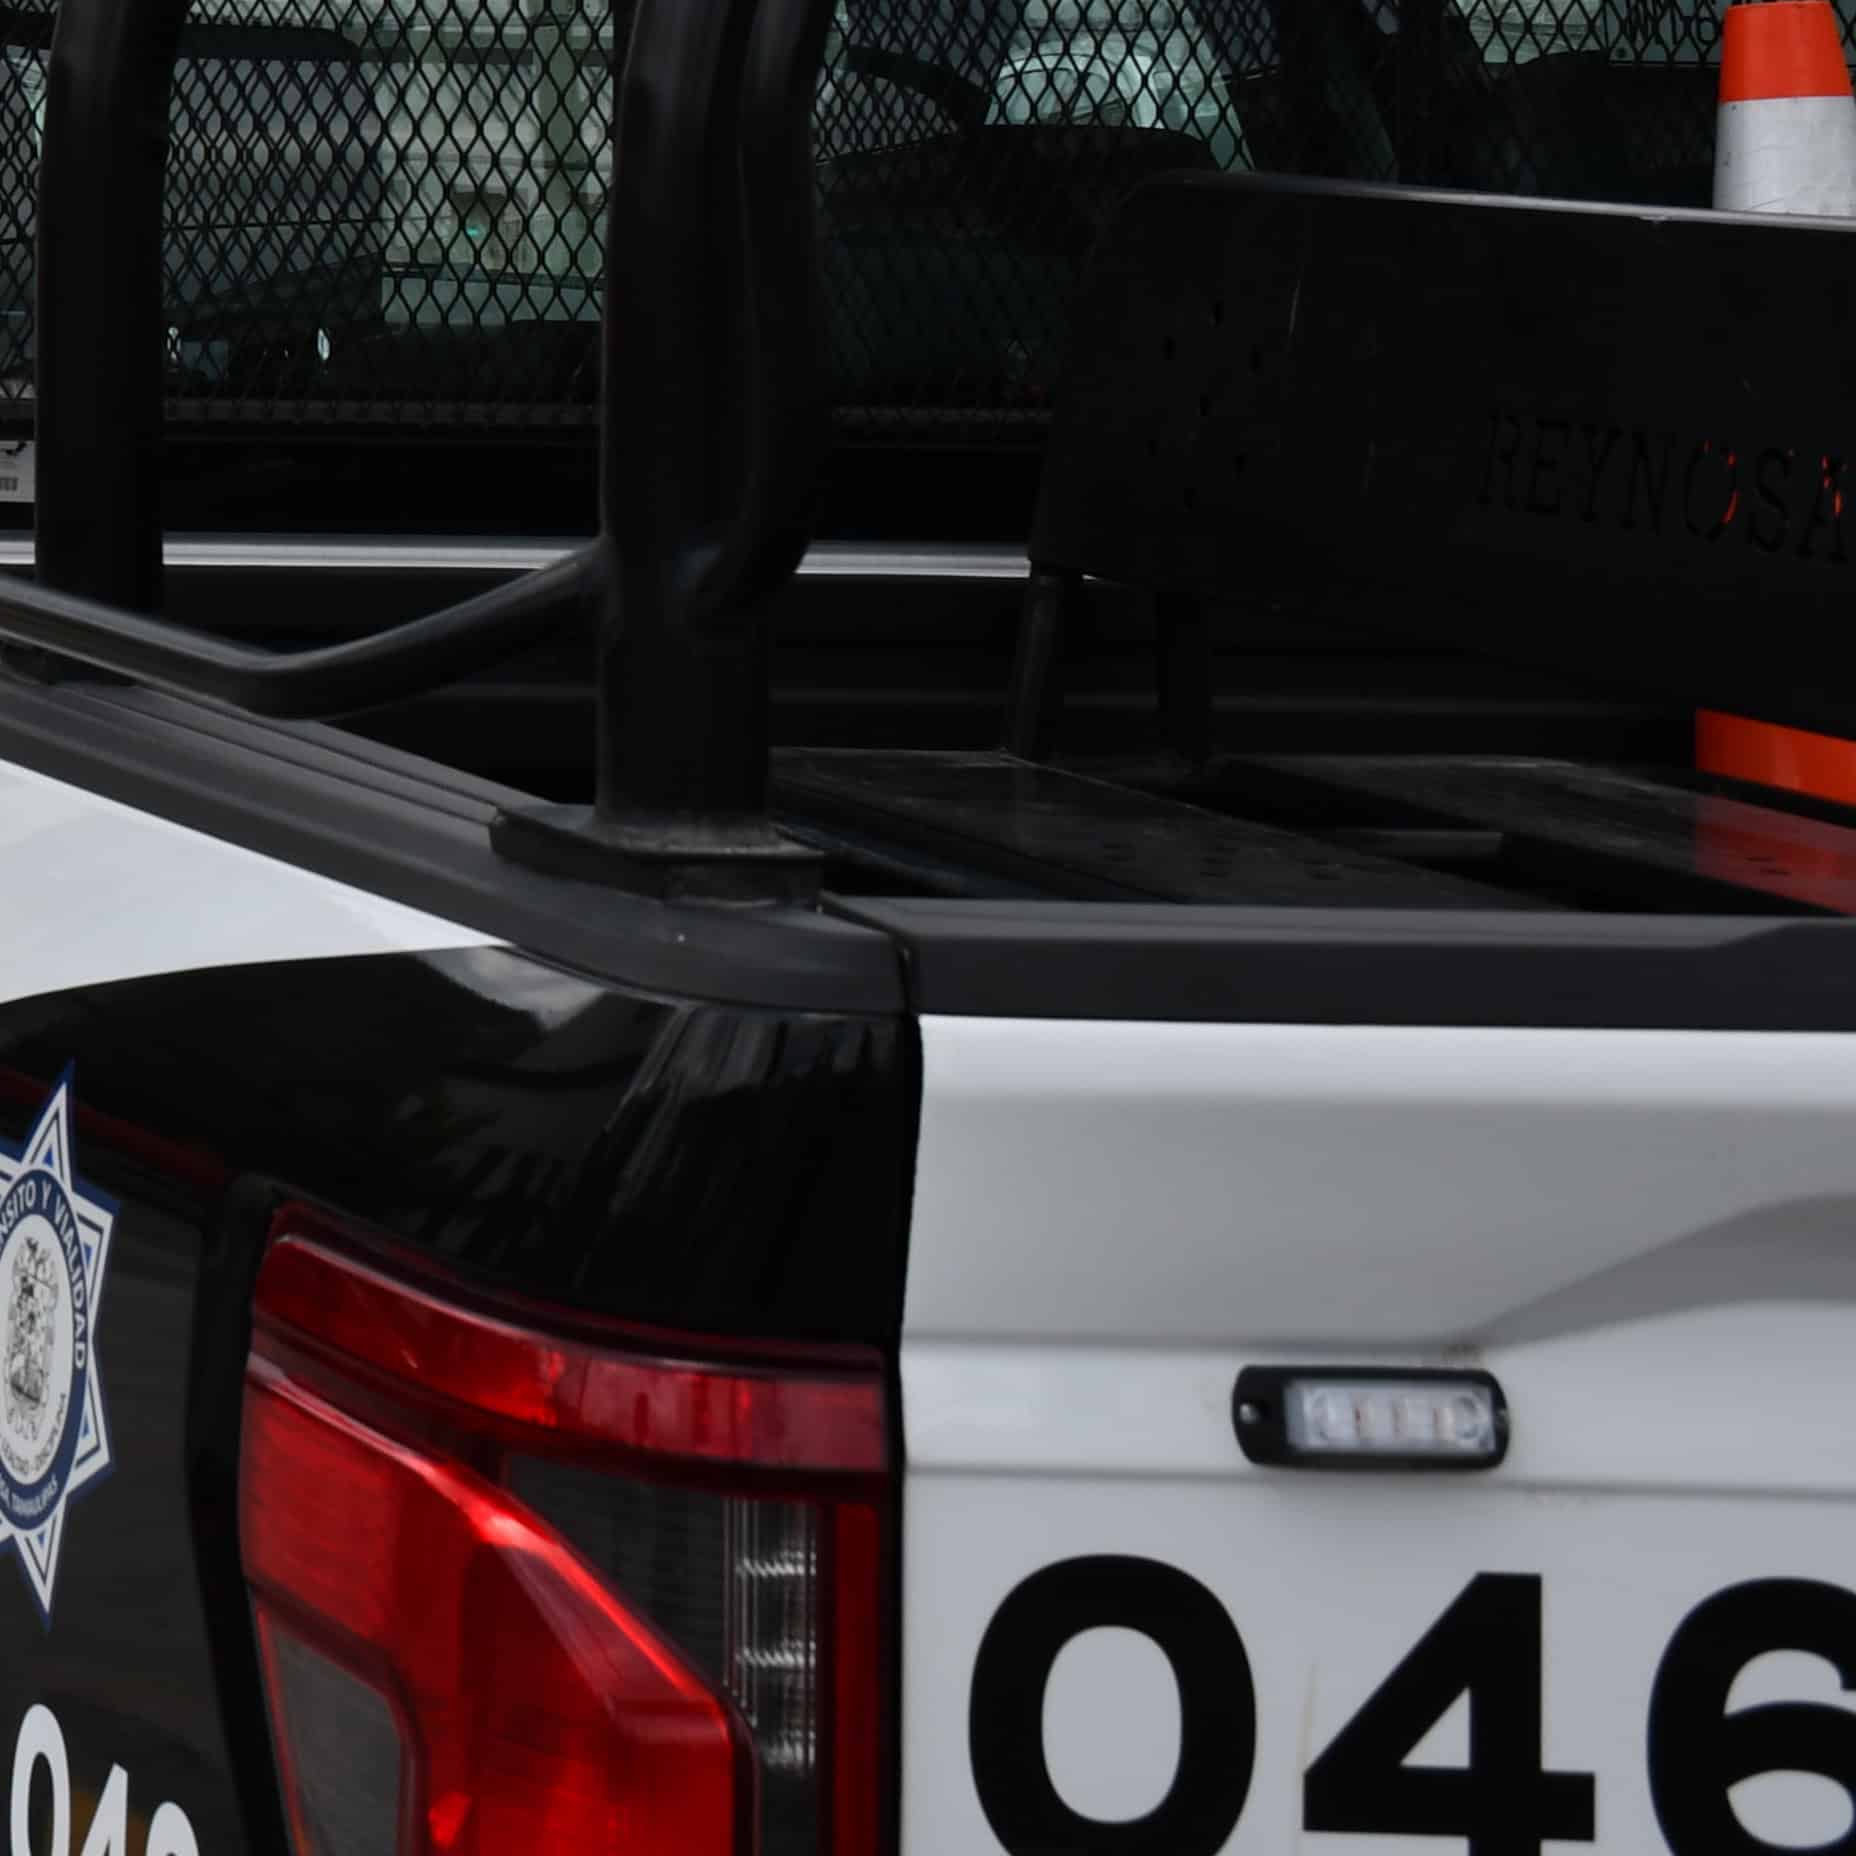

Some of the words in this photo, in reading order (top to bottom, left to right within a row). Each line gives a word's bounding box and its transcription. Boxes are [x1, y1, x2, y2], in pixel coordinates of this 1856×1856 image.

[41, 1180, 52, 1209] Y
[52, 1196, 87, 1369] VIALIDAD
[969, 1553, 1856, 1856] 046
